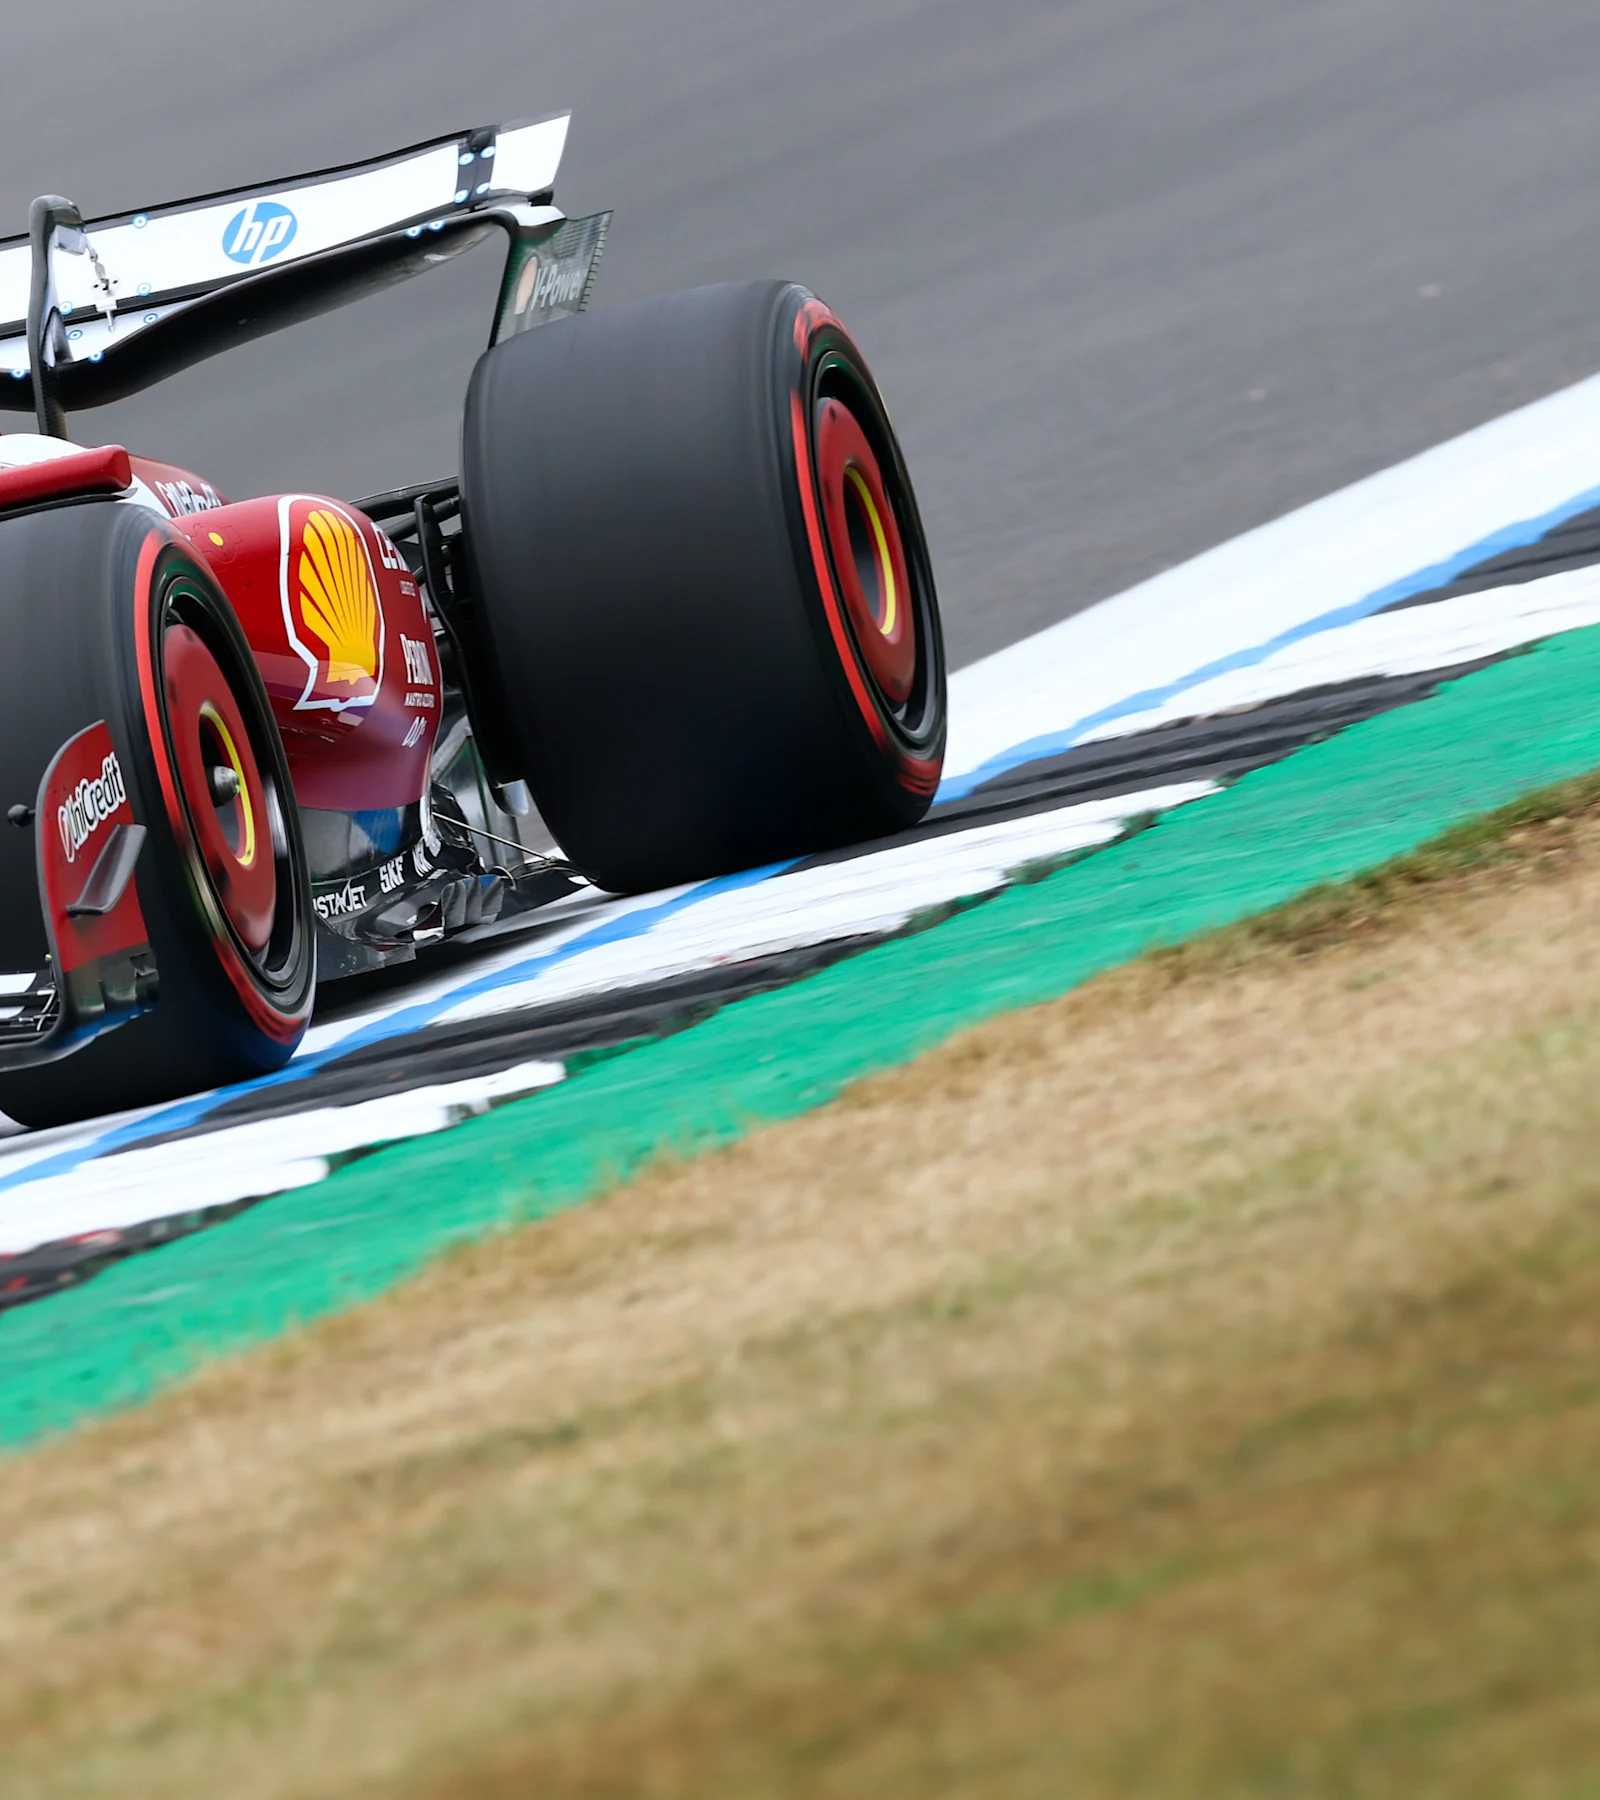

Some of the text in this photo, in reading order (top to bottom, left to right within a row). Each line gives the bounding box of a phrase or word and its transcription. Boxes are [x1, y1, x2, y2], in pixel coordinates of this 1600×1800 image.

[227, 202, 295, 264] hp
[66, 752, 126, 850] UniCredit
[312, 880, 368, 919] ISTAJET
[379, 856, 405, 893] SKF
